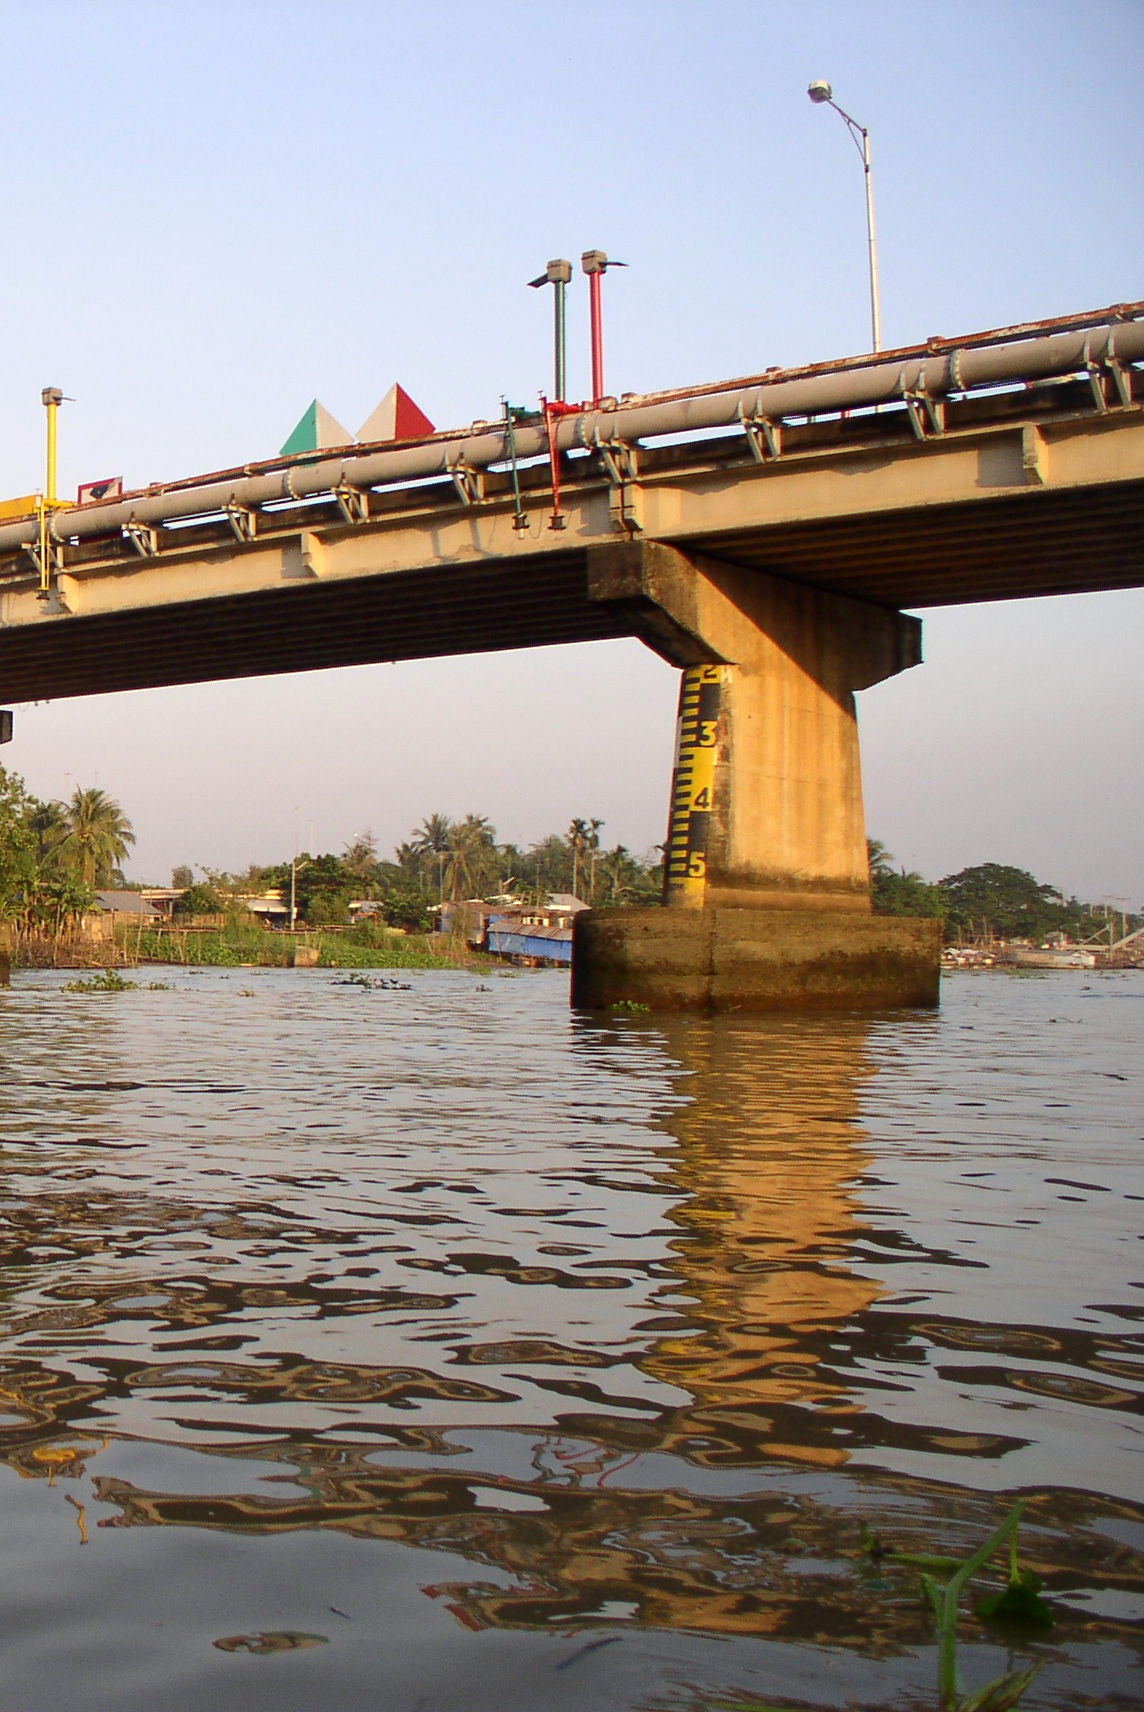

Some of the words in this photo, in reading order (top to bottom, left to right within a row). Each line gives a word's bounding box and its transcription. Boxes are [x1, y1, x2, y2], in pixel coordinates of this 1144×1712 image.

[700, 720, 718, 746] 3
[694, 787, 710, 809] 4
[688, 850, 706, 877] 5
